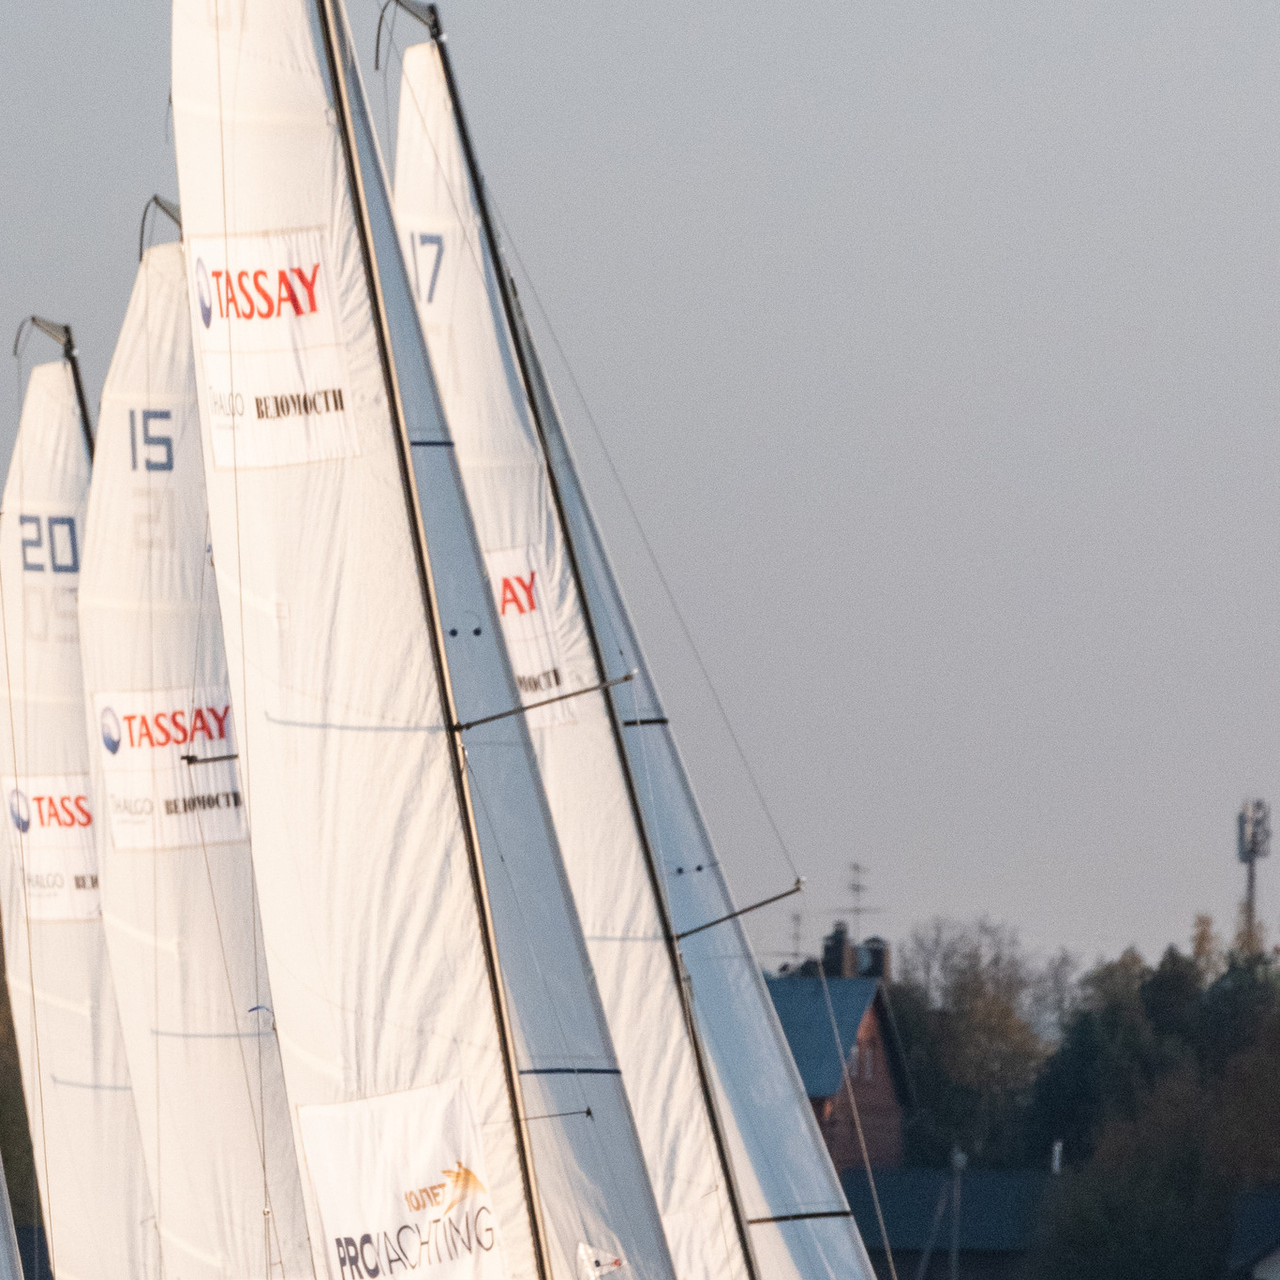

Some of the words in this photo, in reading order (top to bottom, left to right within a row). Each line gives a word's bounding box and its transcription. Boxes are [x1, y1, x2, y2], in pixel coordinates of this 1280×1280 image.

[211, 263, 320, 320] TASSAY
[129, 409, 174, 472] 15
[19, 516, 80, 574] 20
[123, 705, 230, 748] TASSAY
